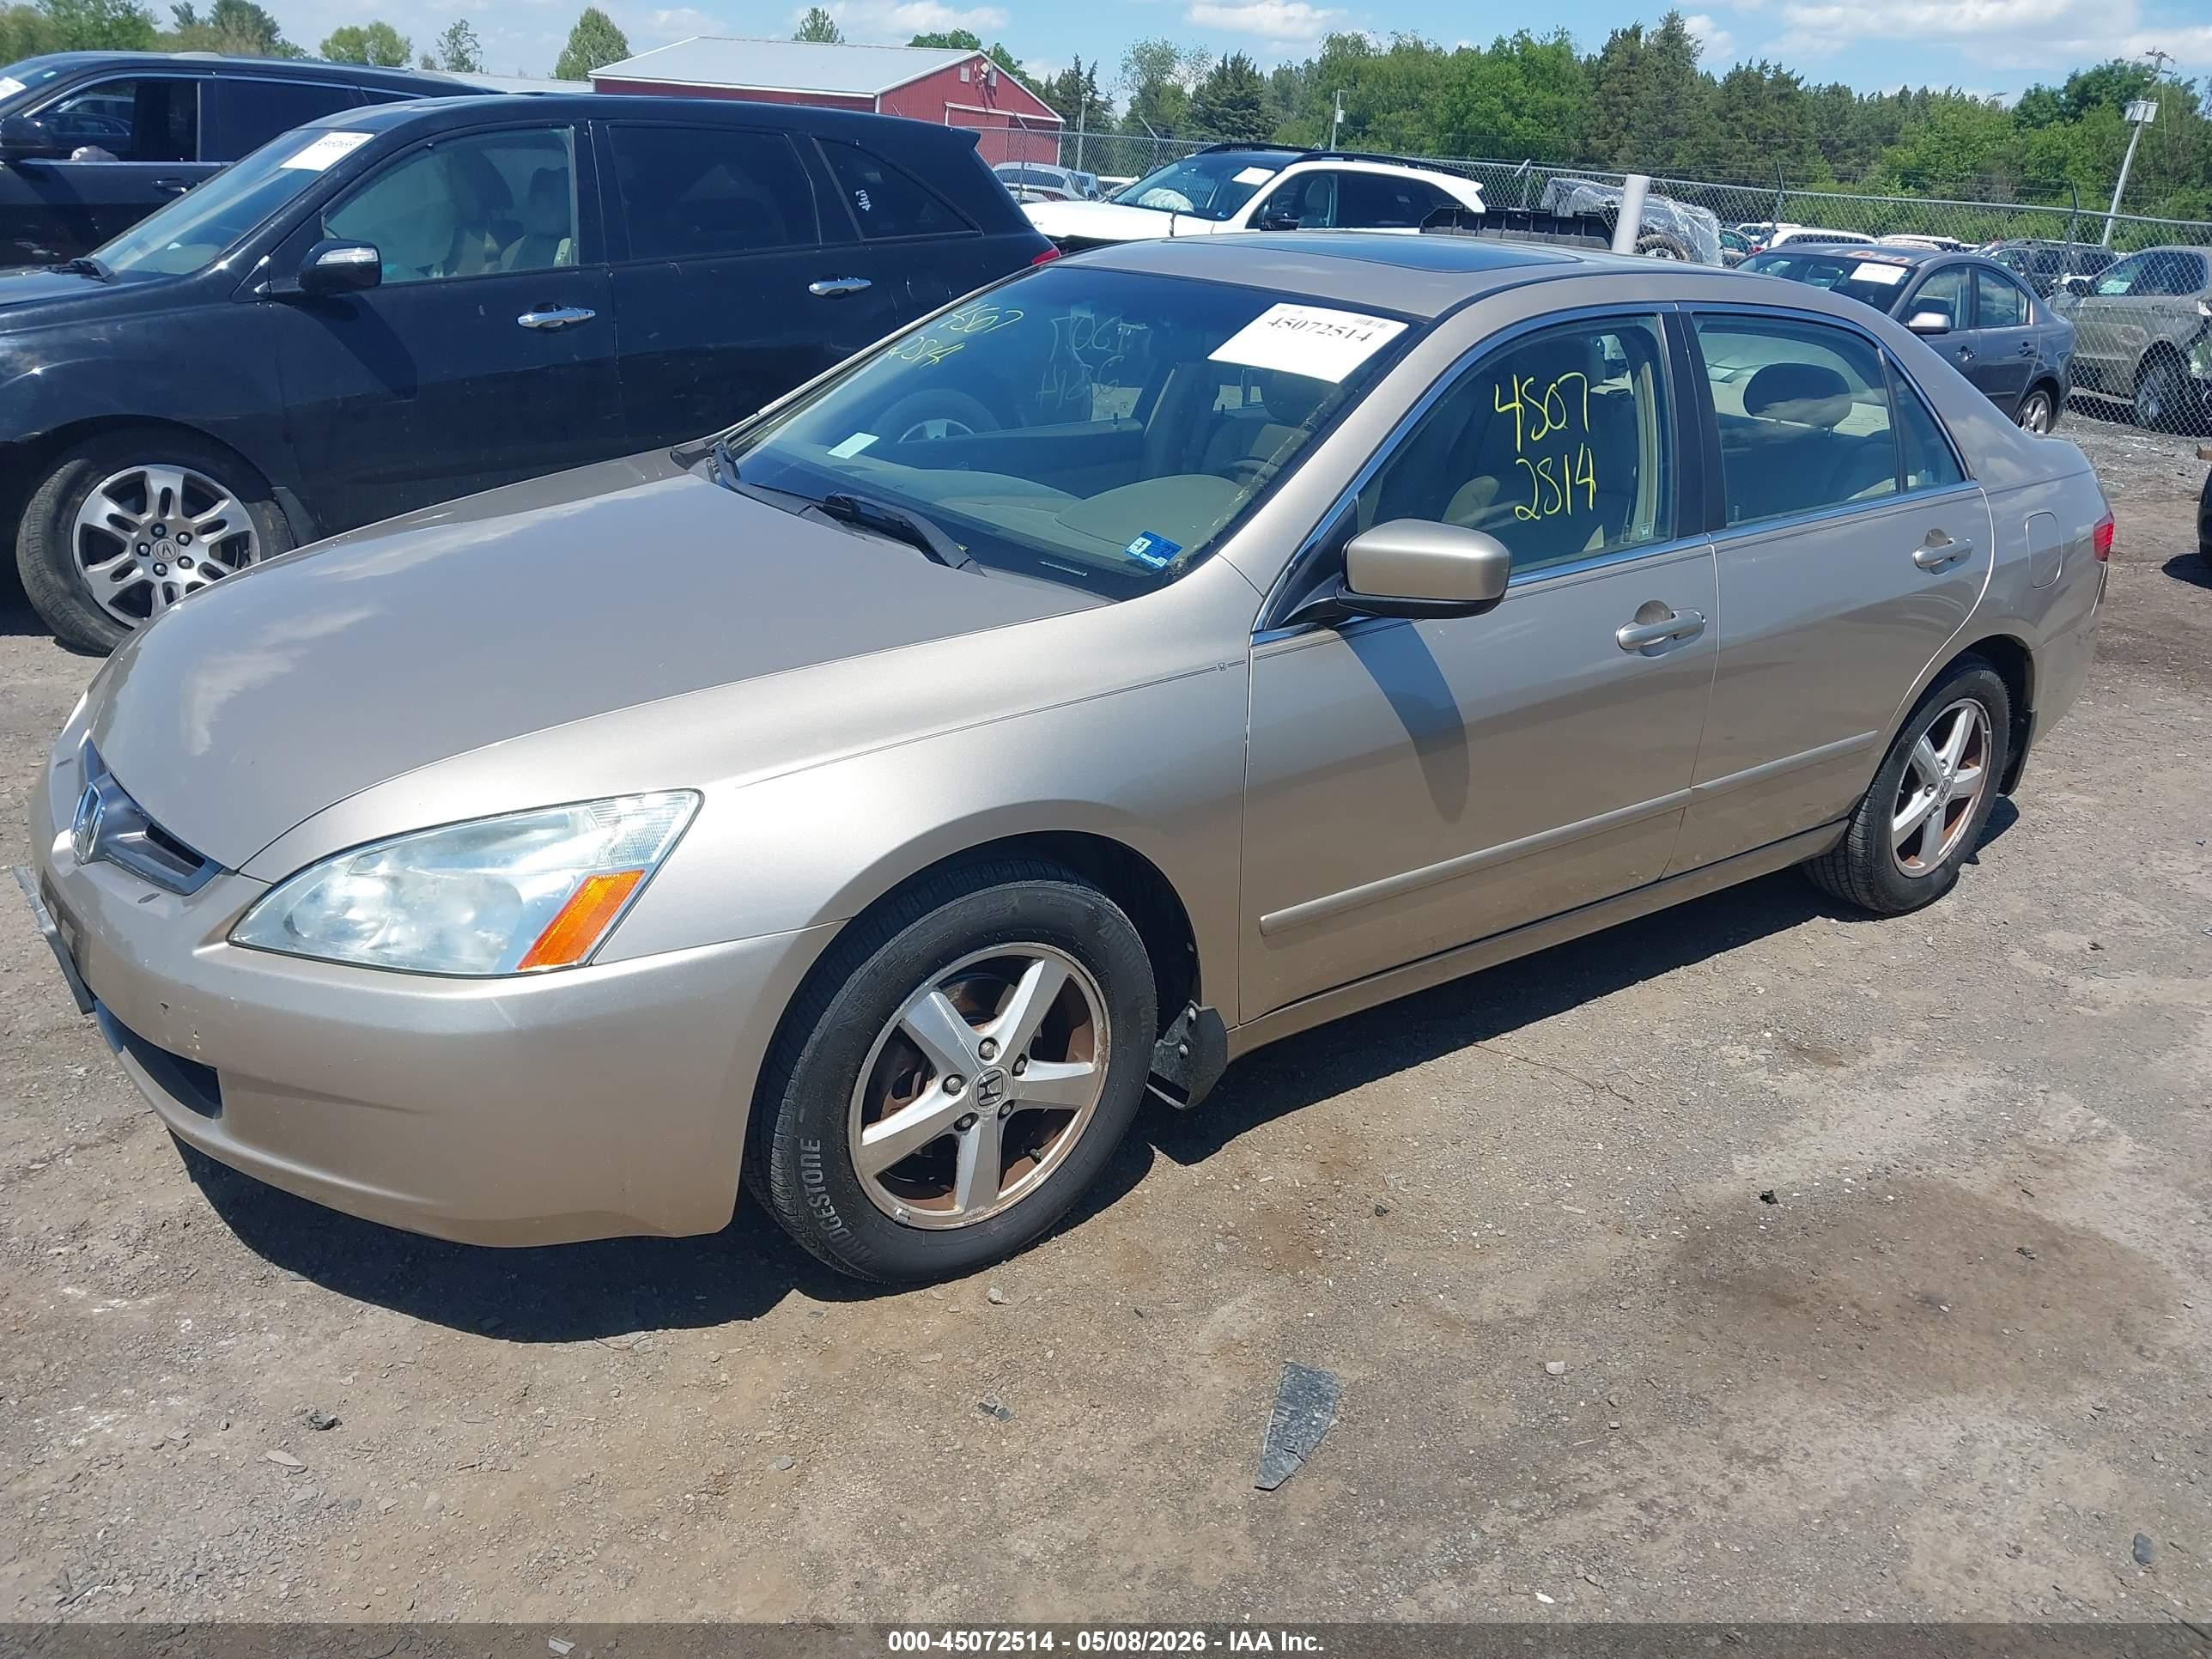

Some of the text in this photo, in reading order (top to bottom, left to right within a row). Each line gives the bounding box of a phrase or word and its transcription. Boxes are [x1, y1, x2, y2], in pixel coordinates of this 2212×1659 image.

[939, 303, 1024, 334] 4507
[1267, 317, 1374, 343] 45072514
[1494, 372, 1589, 453] 4507
